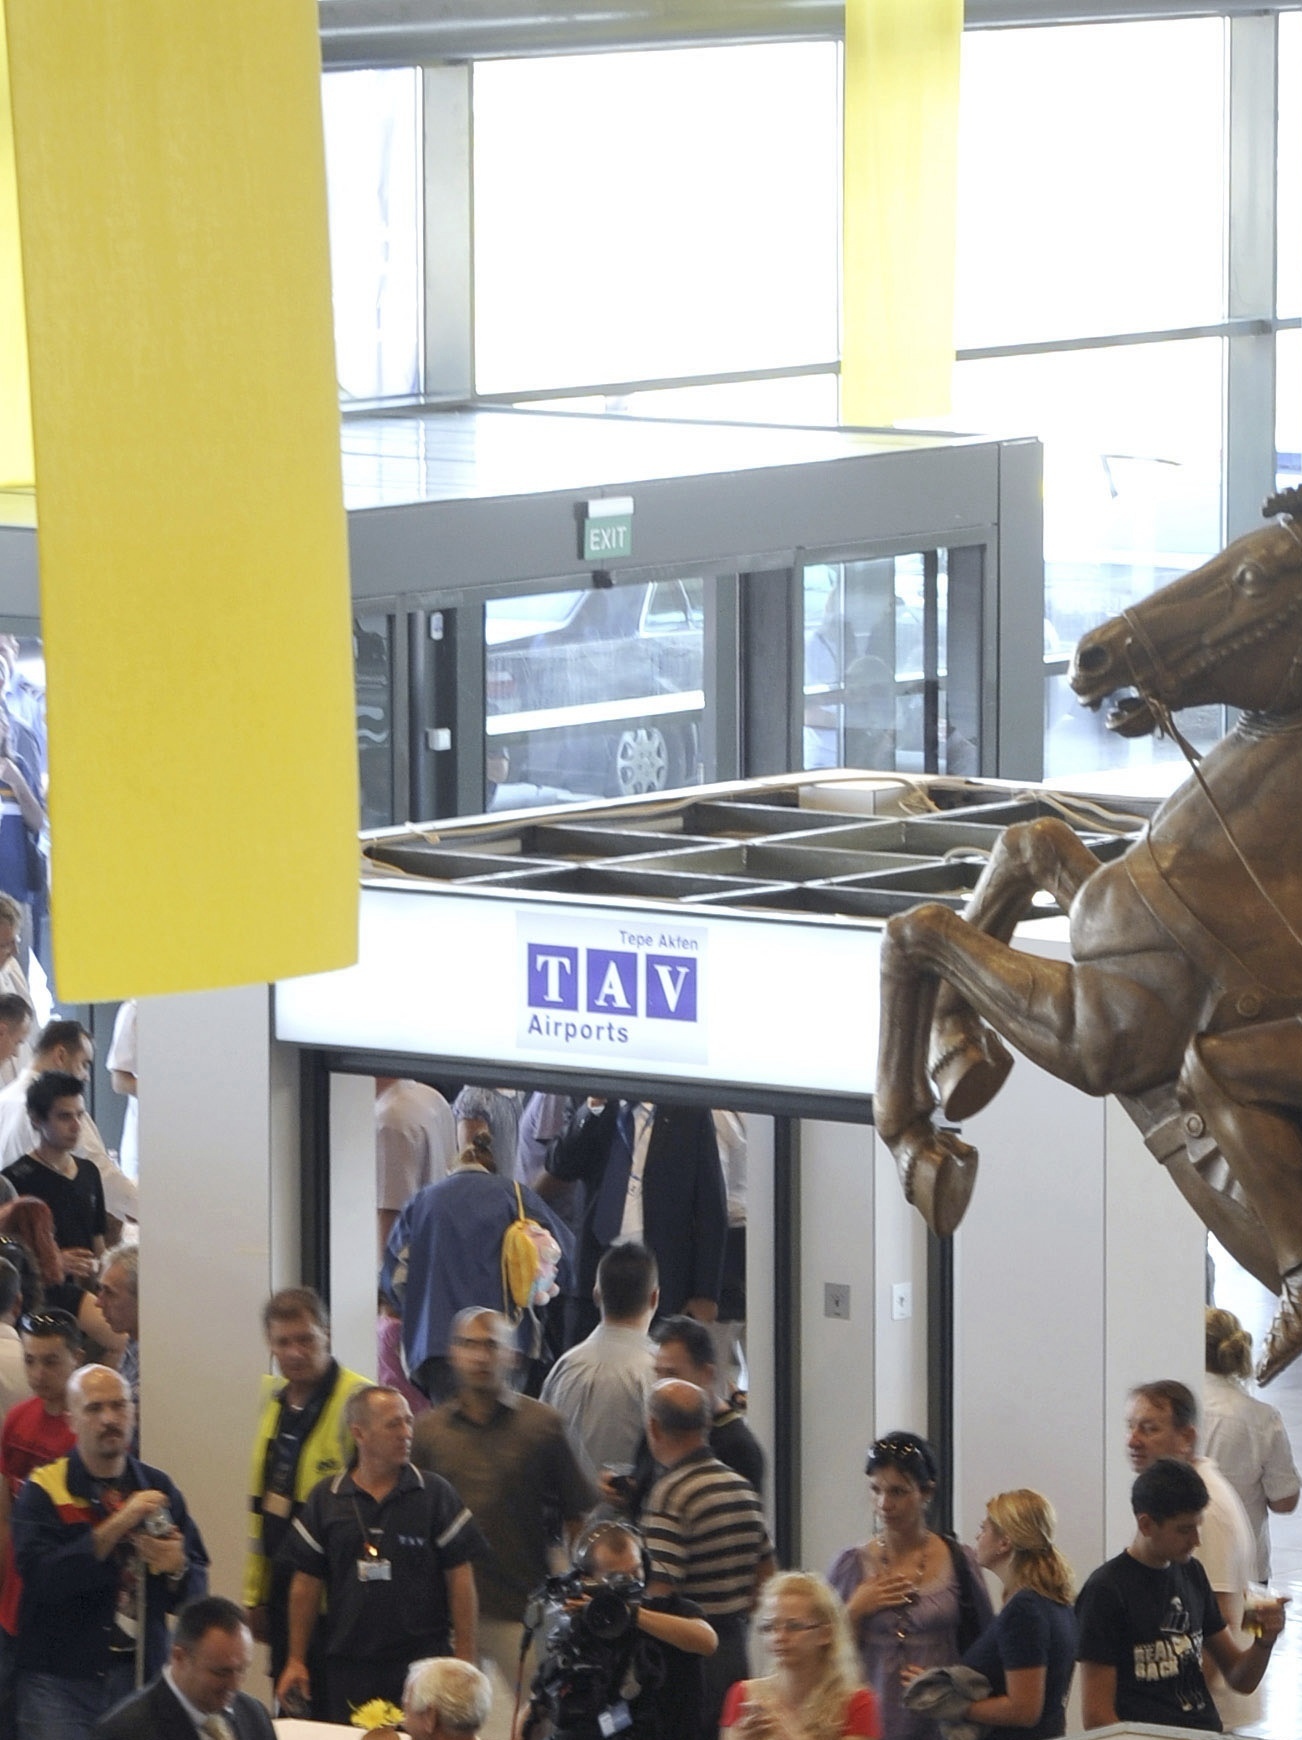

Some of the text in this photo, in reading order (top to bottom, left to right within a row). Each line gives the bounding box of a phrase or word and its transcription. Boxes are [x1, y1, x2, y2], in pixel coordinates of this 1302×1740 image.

[590, 526, 627, 551] EXIT
[619, 930, 653, 948] Tepe
[536, 953, 691, 1014] TAV
[528, 1014, 629, 1043] Airports
